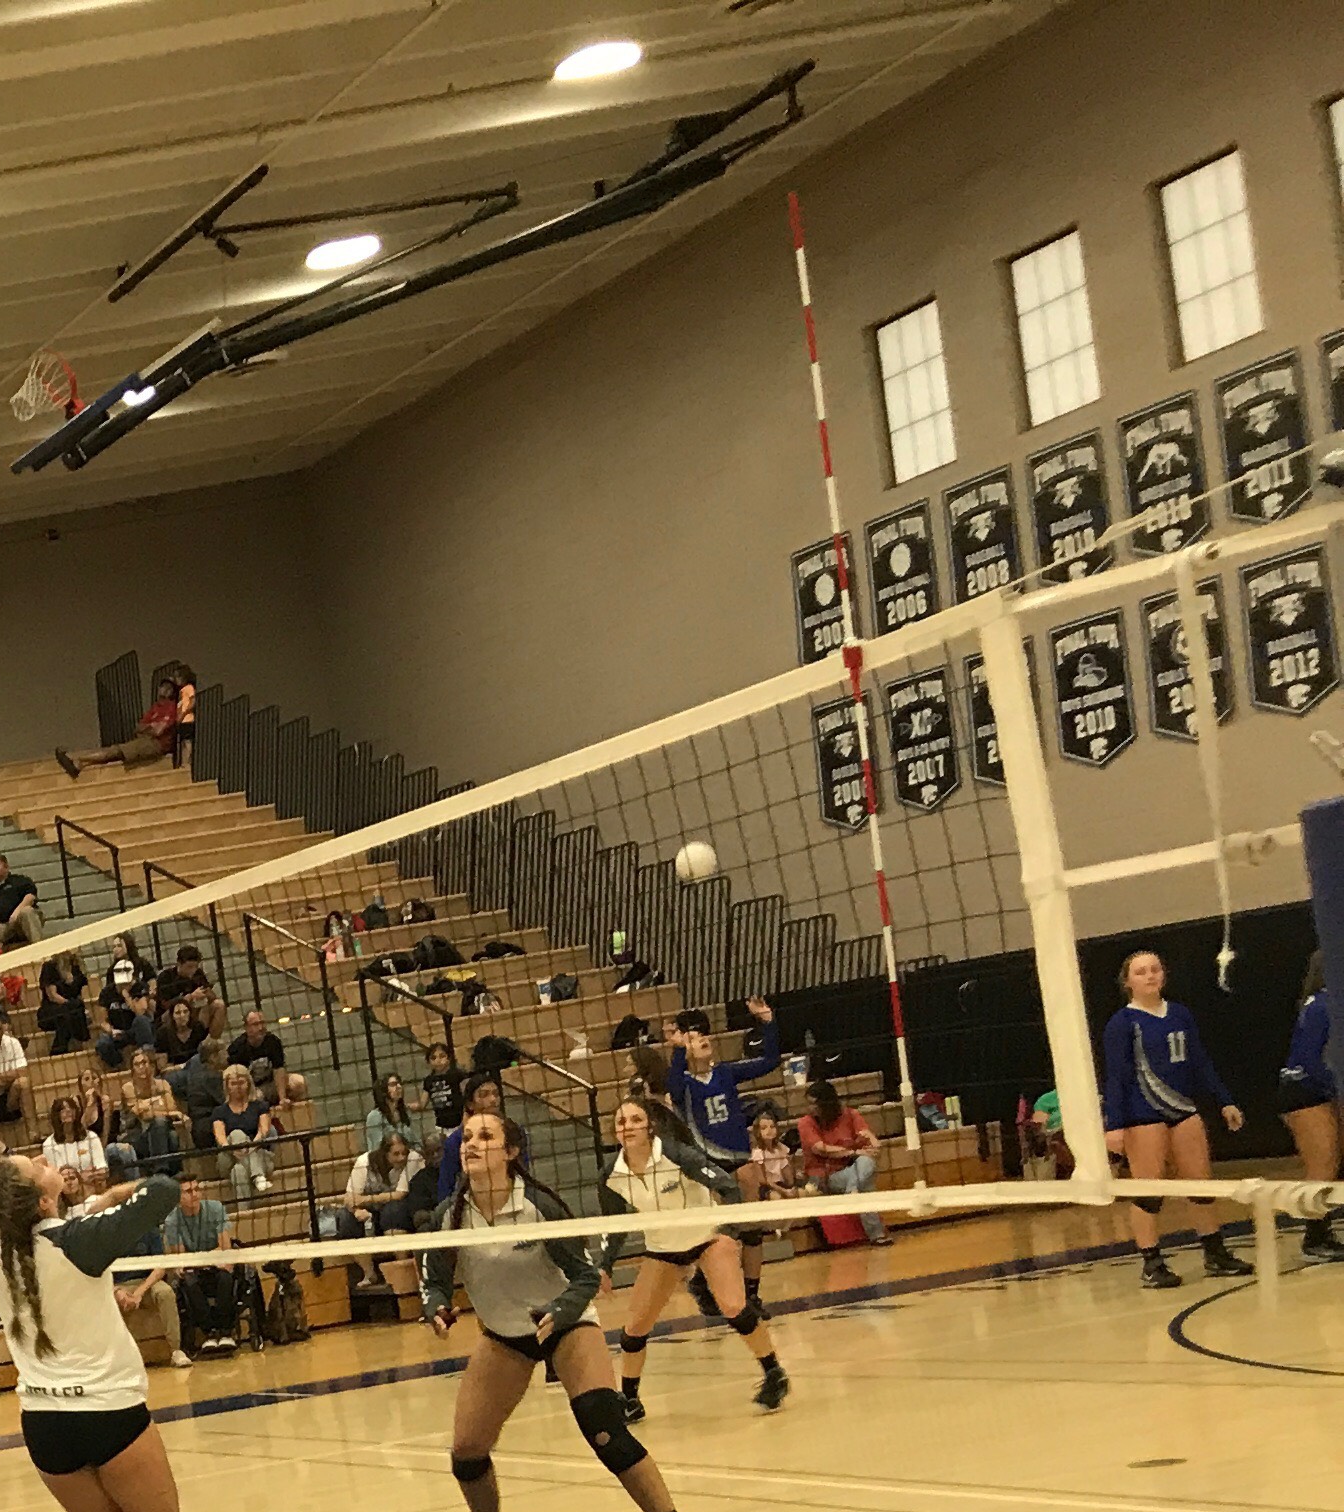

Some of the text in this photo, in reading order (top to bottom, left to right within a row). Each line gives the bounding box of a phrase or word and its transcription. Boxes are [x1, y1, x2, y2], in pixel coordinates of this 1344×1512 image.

[814, 620, 844, 652] 200
[1269, 647, 1320, 687] 2012
[907, 754, 946, 786] 2007
[832, 776, 866, 807] 200
[704, 1093, 729, 1125] 15
